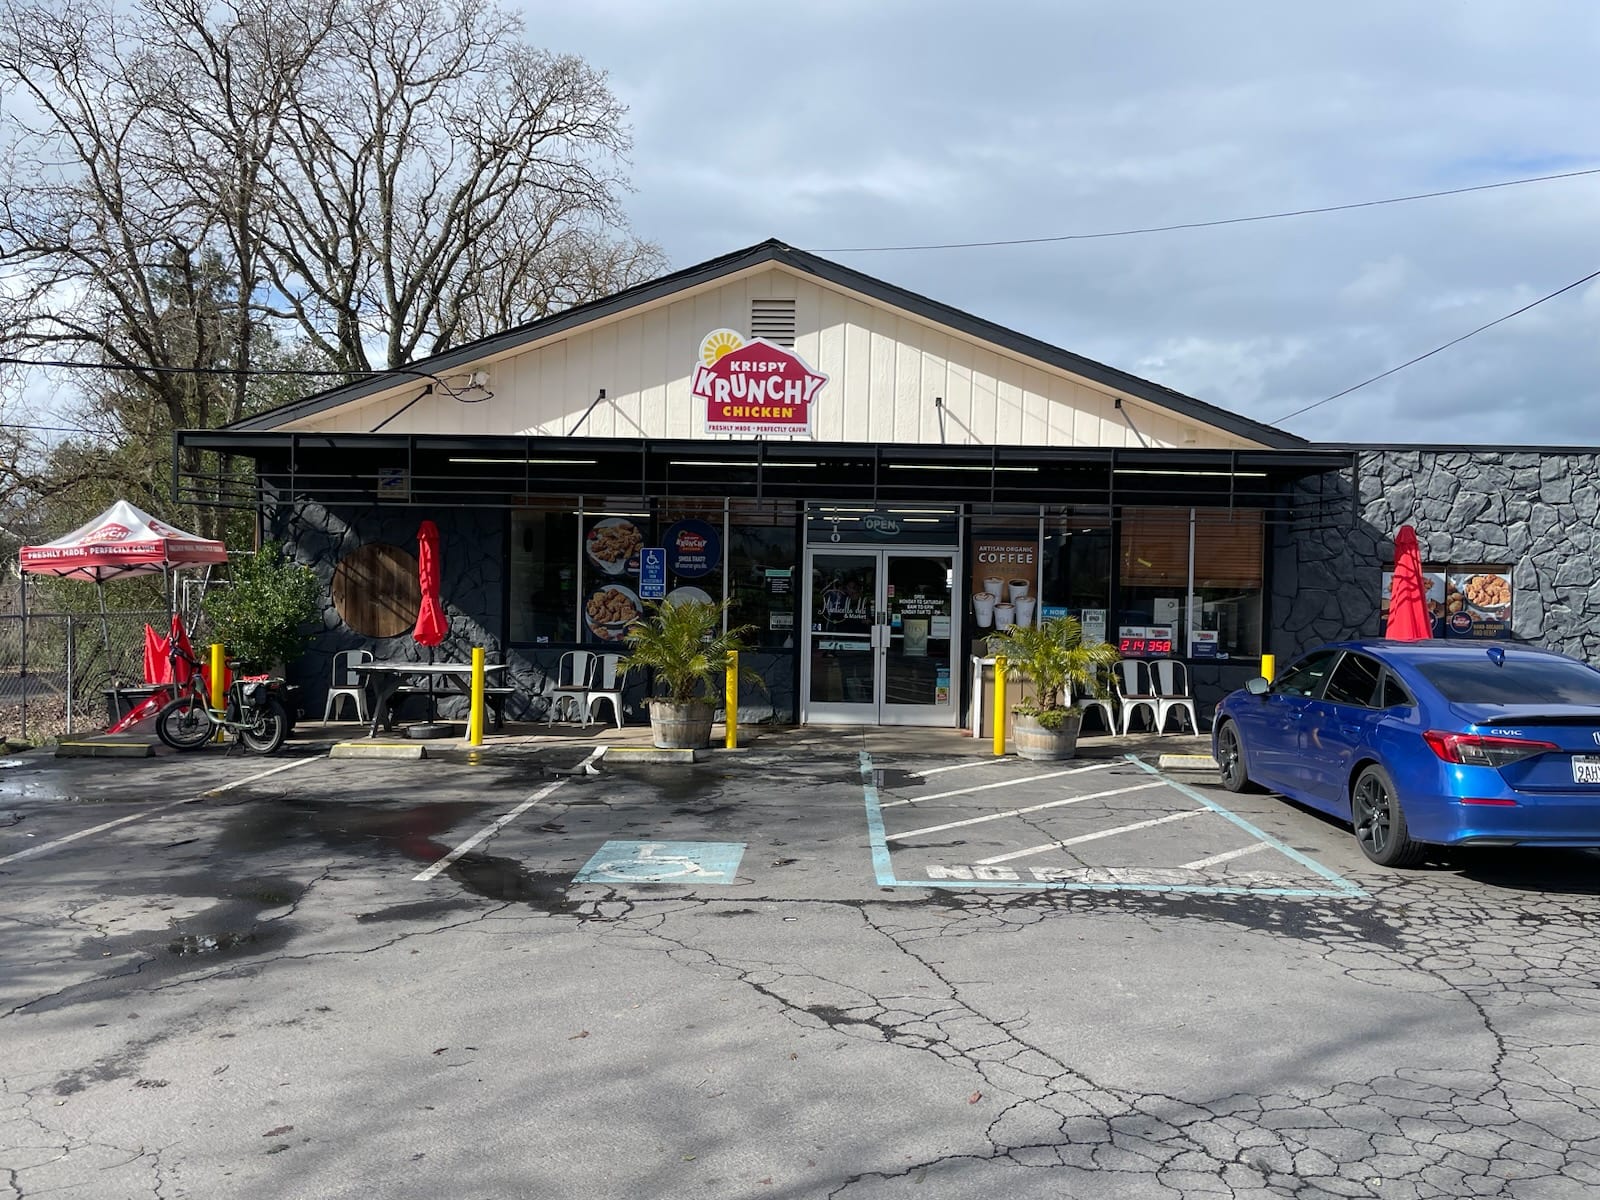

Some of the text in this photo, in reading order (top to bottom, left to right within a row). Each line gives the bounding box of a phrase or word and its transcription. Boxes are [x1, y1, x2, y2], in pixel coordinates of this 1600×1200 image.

[730, 361, 787, 373] KRISPY
[695, 369, 824, 405] KRUNCHY
[722, 406, 793, 419] CHICKEN
[866, 519, 896, 531] OPEN
[676, 538, 708, 548] KRUNCHY
[28, 545, 157, 560] FRESHLY MADE, PERFECTLY CAJUN
[978, 553, 1033, 563] COFFEE
[1120, 640, 1171, 652] 214 358
[925, 865, 1020, 881] NO
